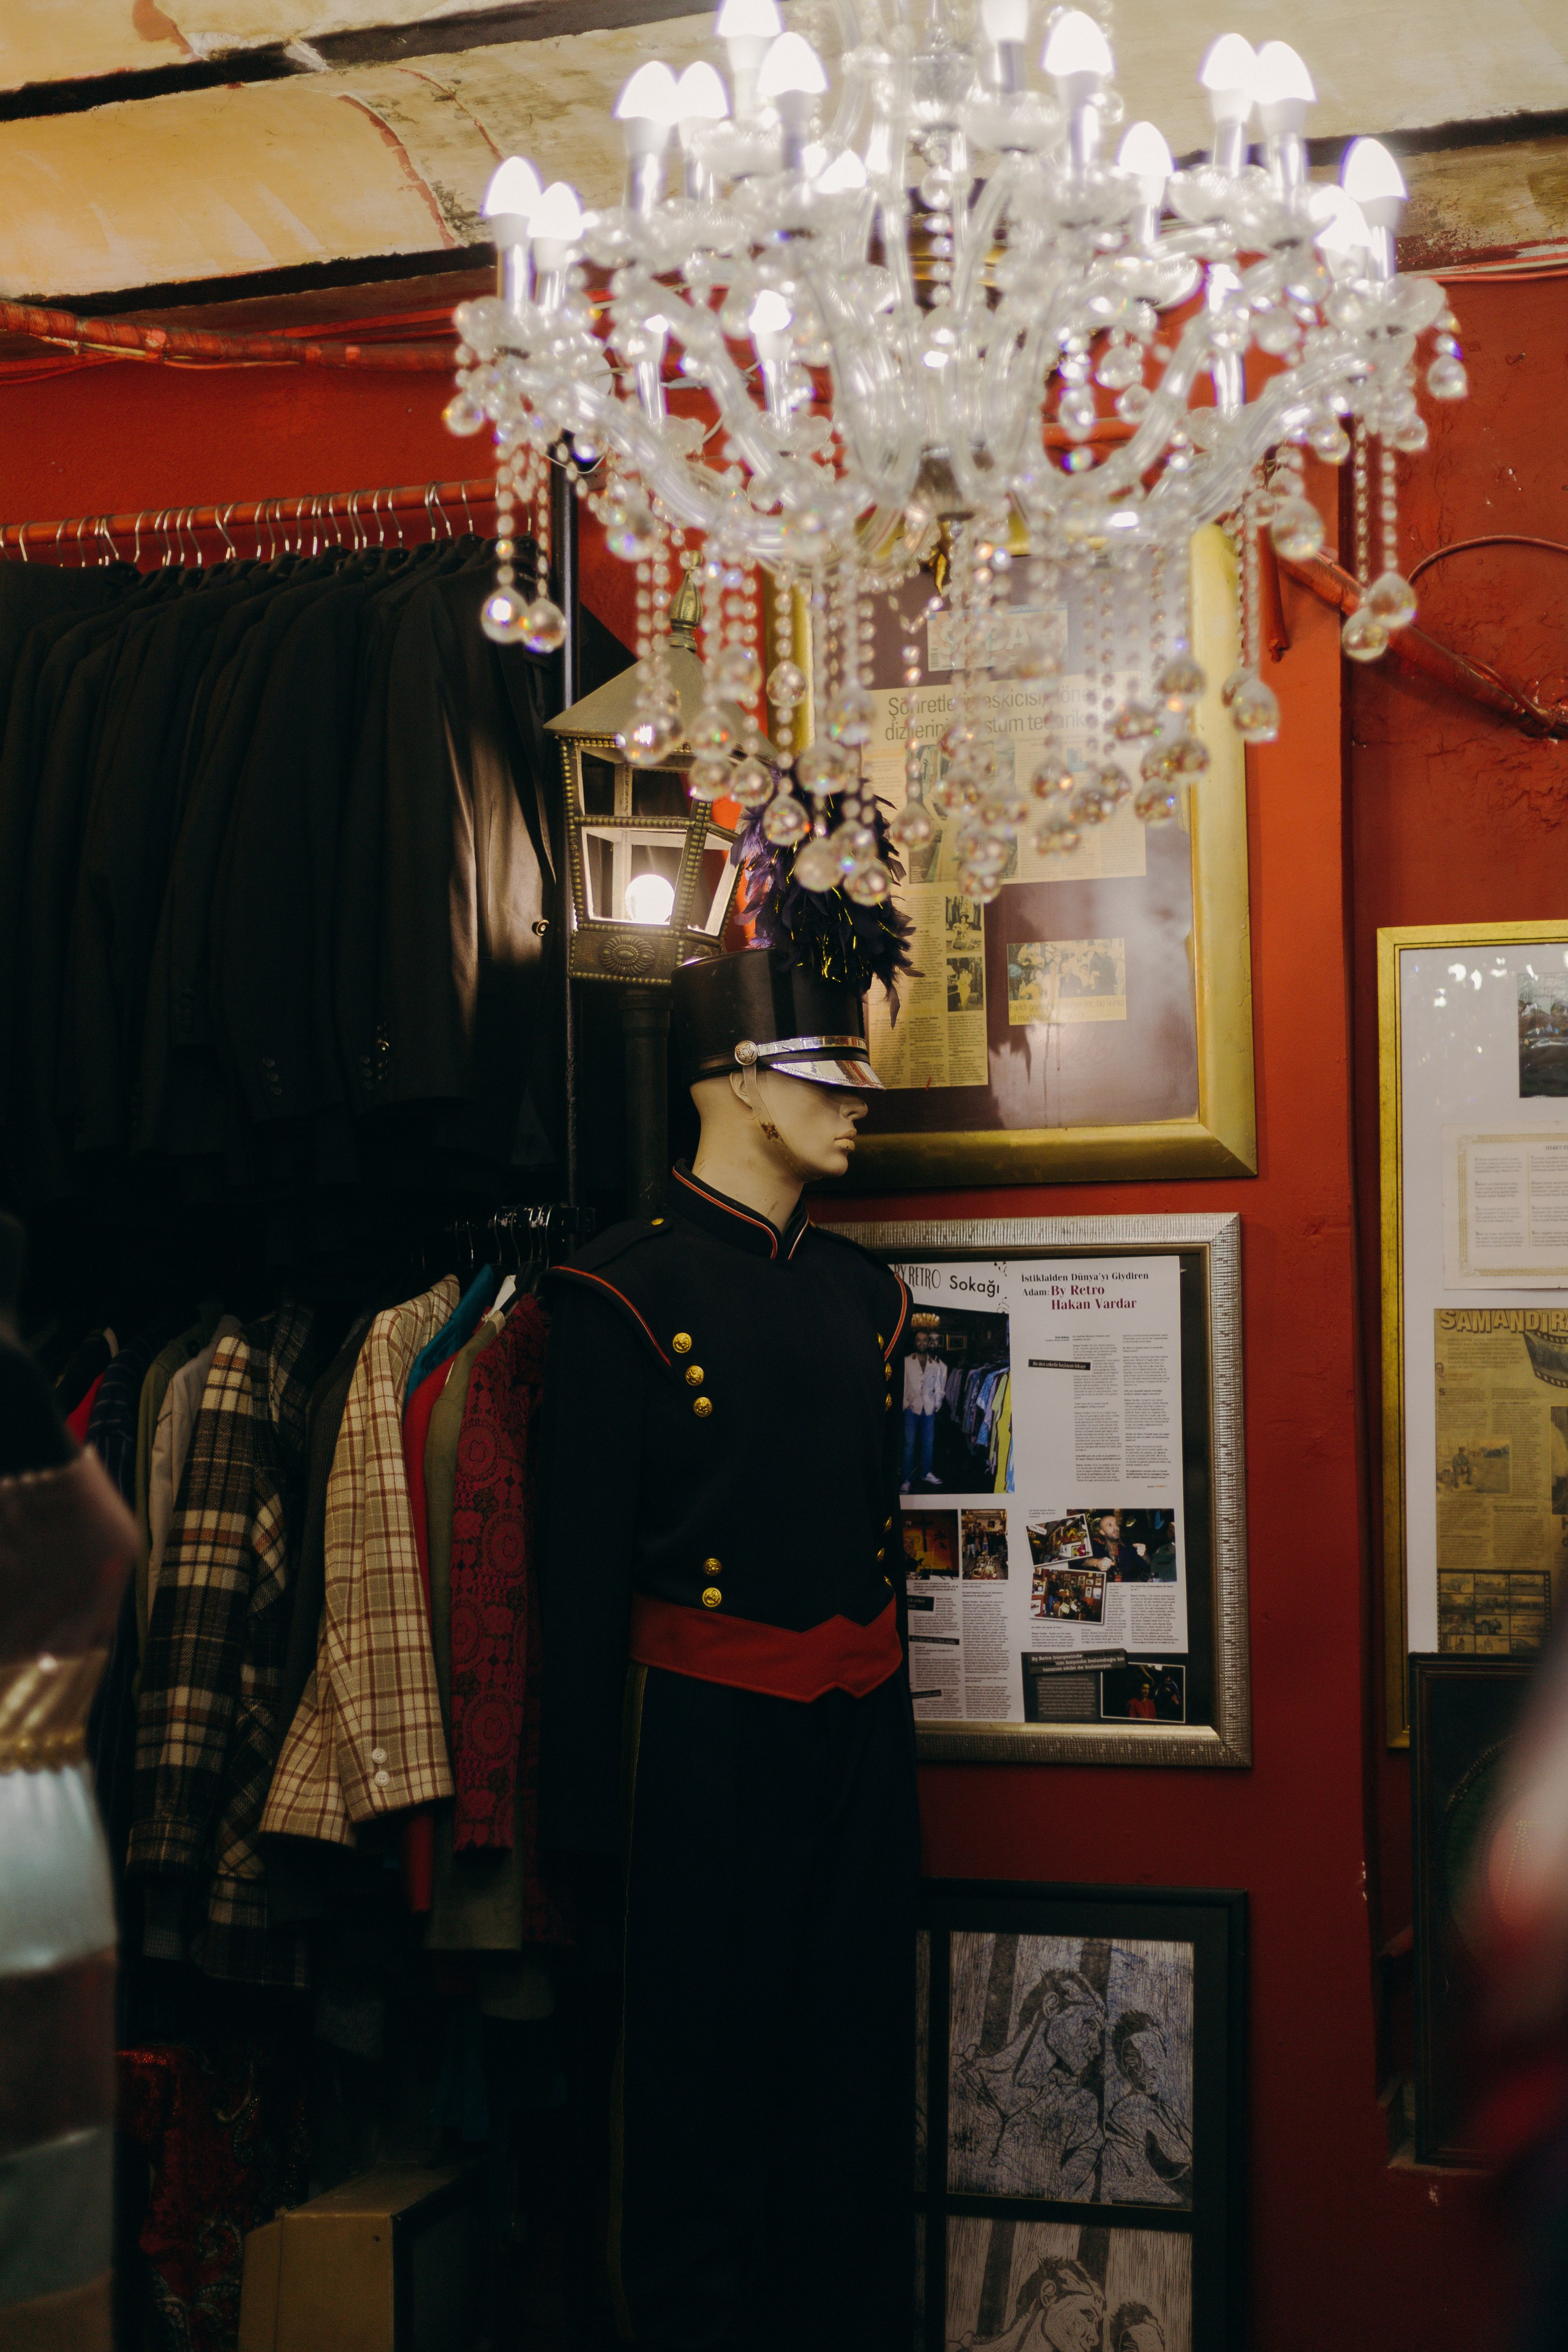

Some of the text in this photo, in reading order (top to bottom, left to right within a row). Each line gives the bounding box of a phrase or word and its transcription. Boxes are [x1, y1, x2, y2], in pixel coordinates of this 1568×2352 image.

[909, 1265, 941, 1290] RETRO
[949, 1275, 1000, 1298] Sokağı
[1021, 1271, 1149, 1283] İstiklalden Dünya'yı Giydiren
[1022, 1284, 1105, 1298] Adam: By Retro
[1051, 1298, 1137, 1310] Hakan Vardar
[1439, 1310, 1568, 1334] SAMANDIR
